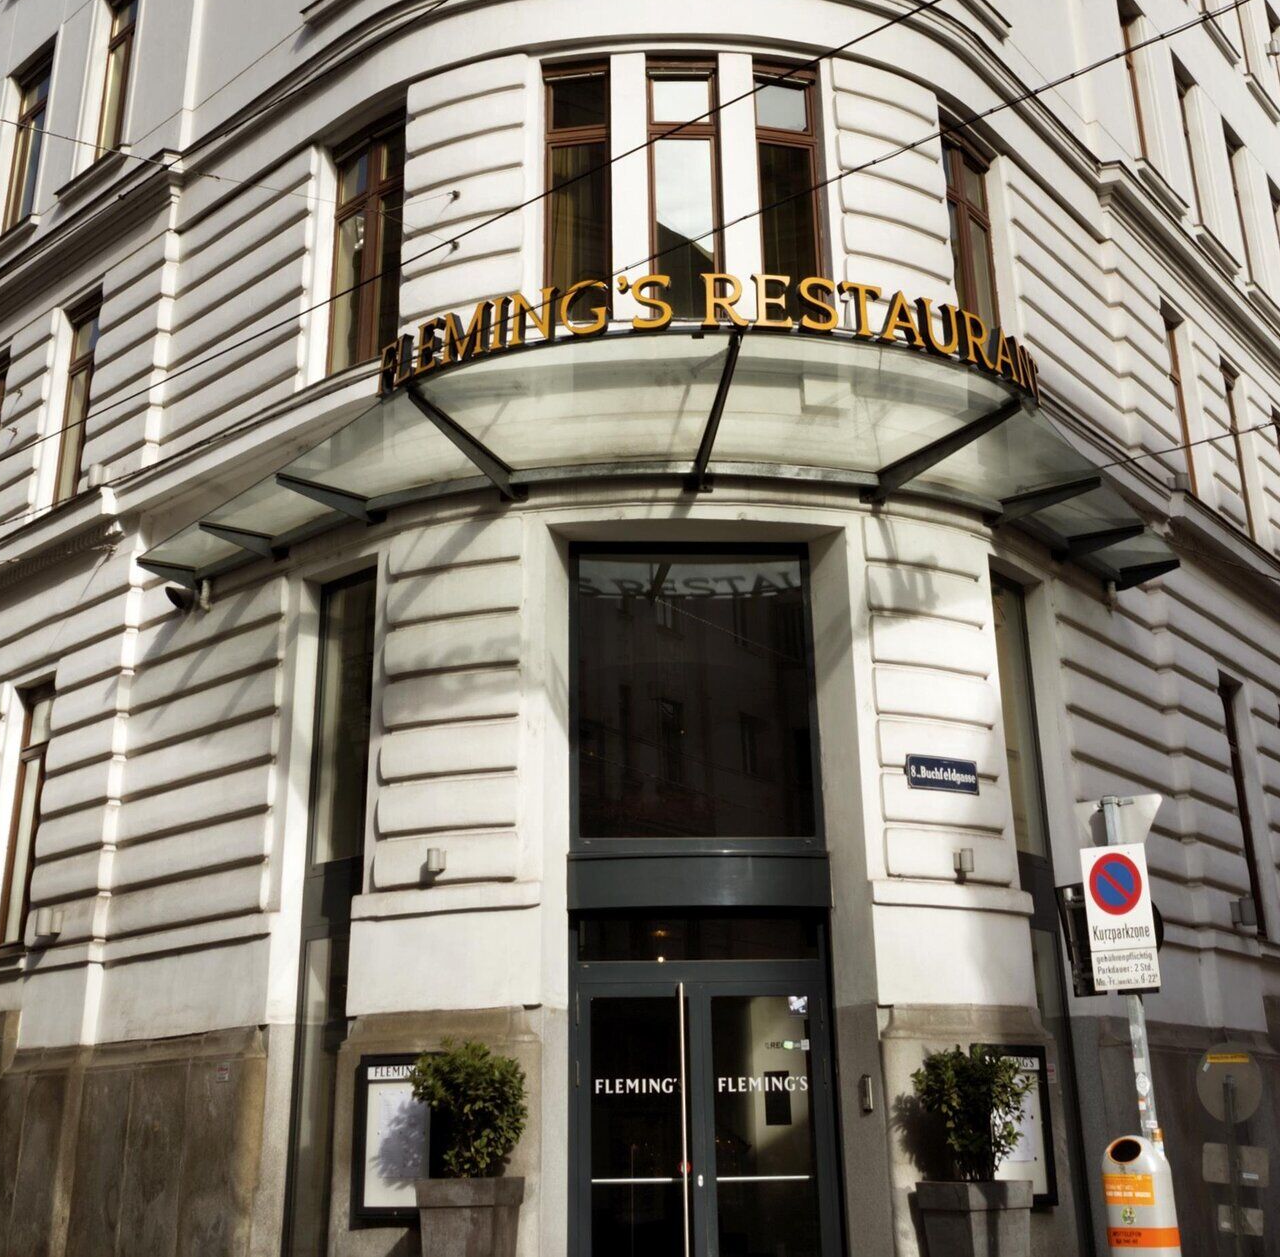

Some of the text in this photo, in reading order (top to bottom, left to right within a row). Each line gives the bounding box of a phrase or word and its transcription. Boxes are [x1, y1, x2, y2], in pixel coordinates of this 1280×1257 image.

[376, 271, 1042, 404] FLEMING'S RESTAURANT
[920, 765, 976, 785] Buchfeldgasse
[1092, 924, 1151, 942] Kurzparkzone
[1134, 963, 1140, 972] 2
[1140, 962, 1154, 972] Std.
[375, 1065, 417, 1077] FLEMIN
[595, 1078, 684, 1094] FLEMING'
[718, 1076, 809, 1092] FLEMING'S
